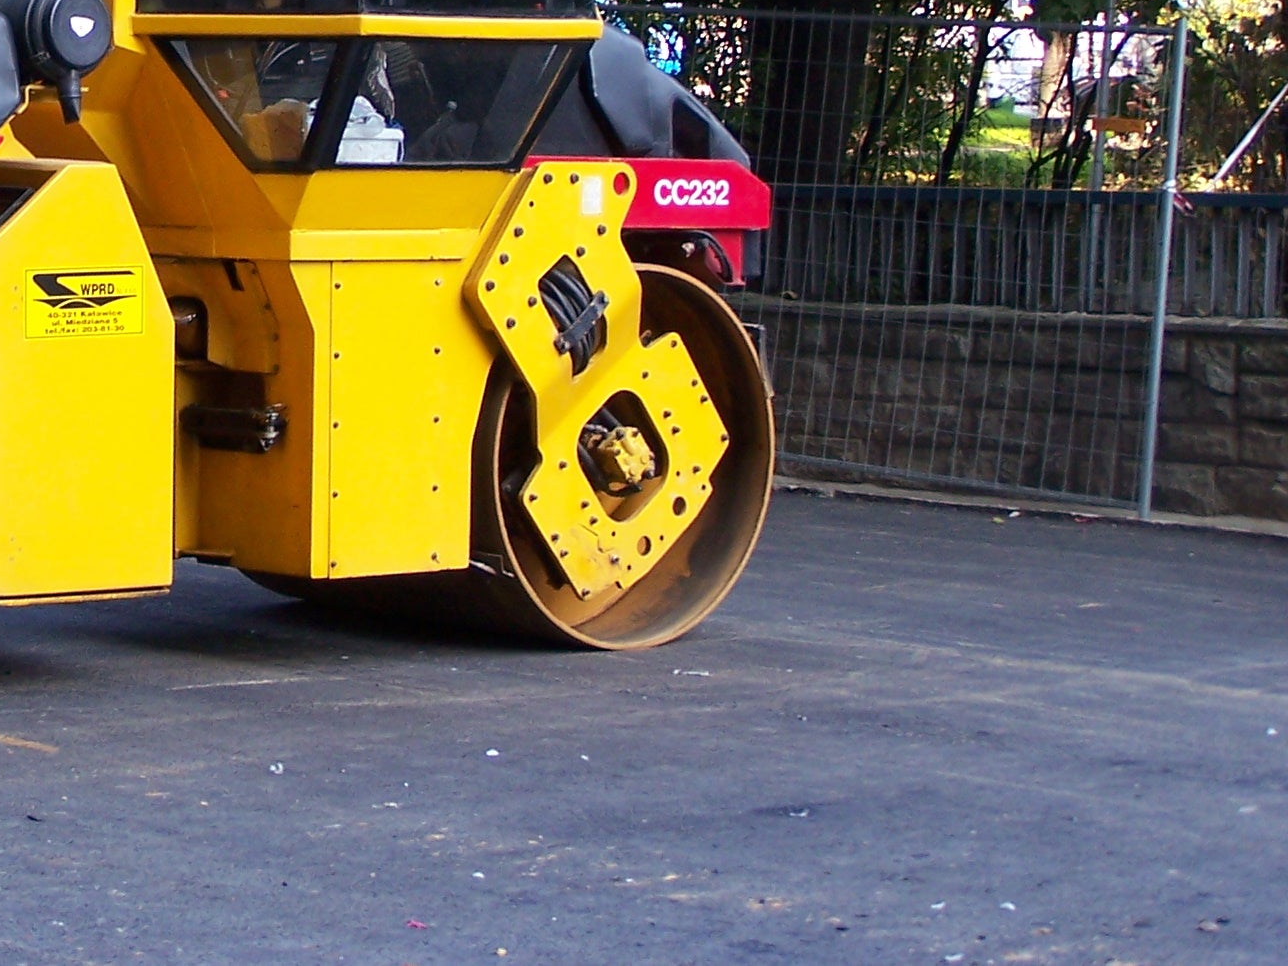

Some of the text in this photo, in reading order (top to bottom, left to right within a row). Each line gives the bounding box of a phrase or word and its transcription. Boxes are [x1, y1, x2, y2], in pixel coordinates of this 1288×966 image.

[653, 178, 730, 206] CC232
[80, 282, 115, 296] WPRD
[80, 309, 123, 317] Katowice
